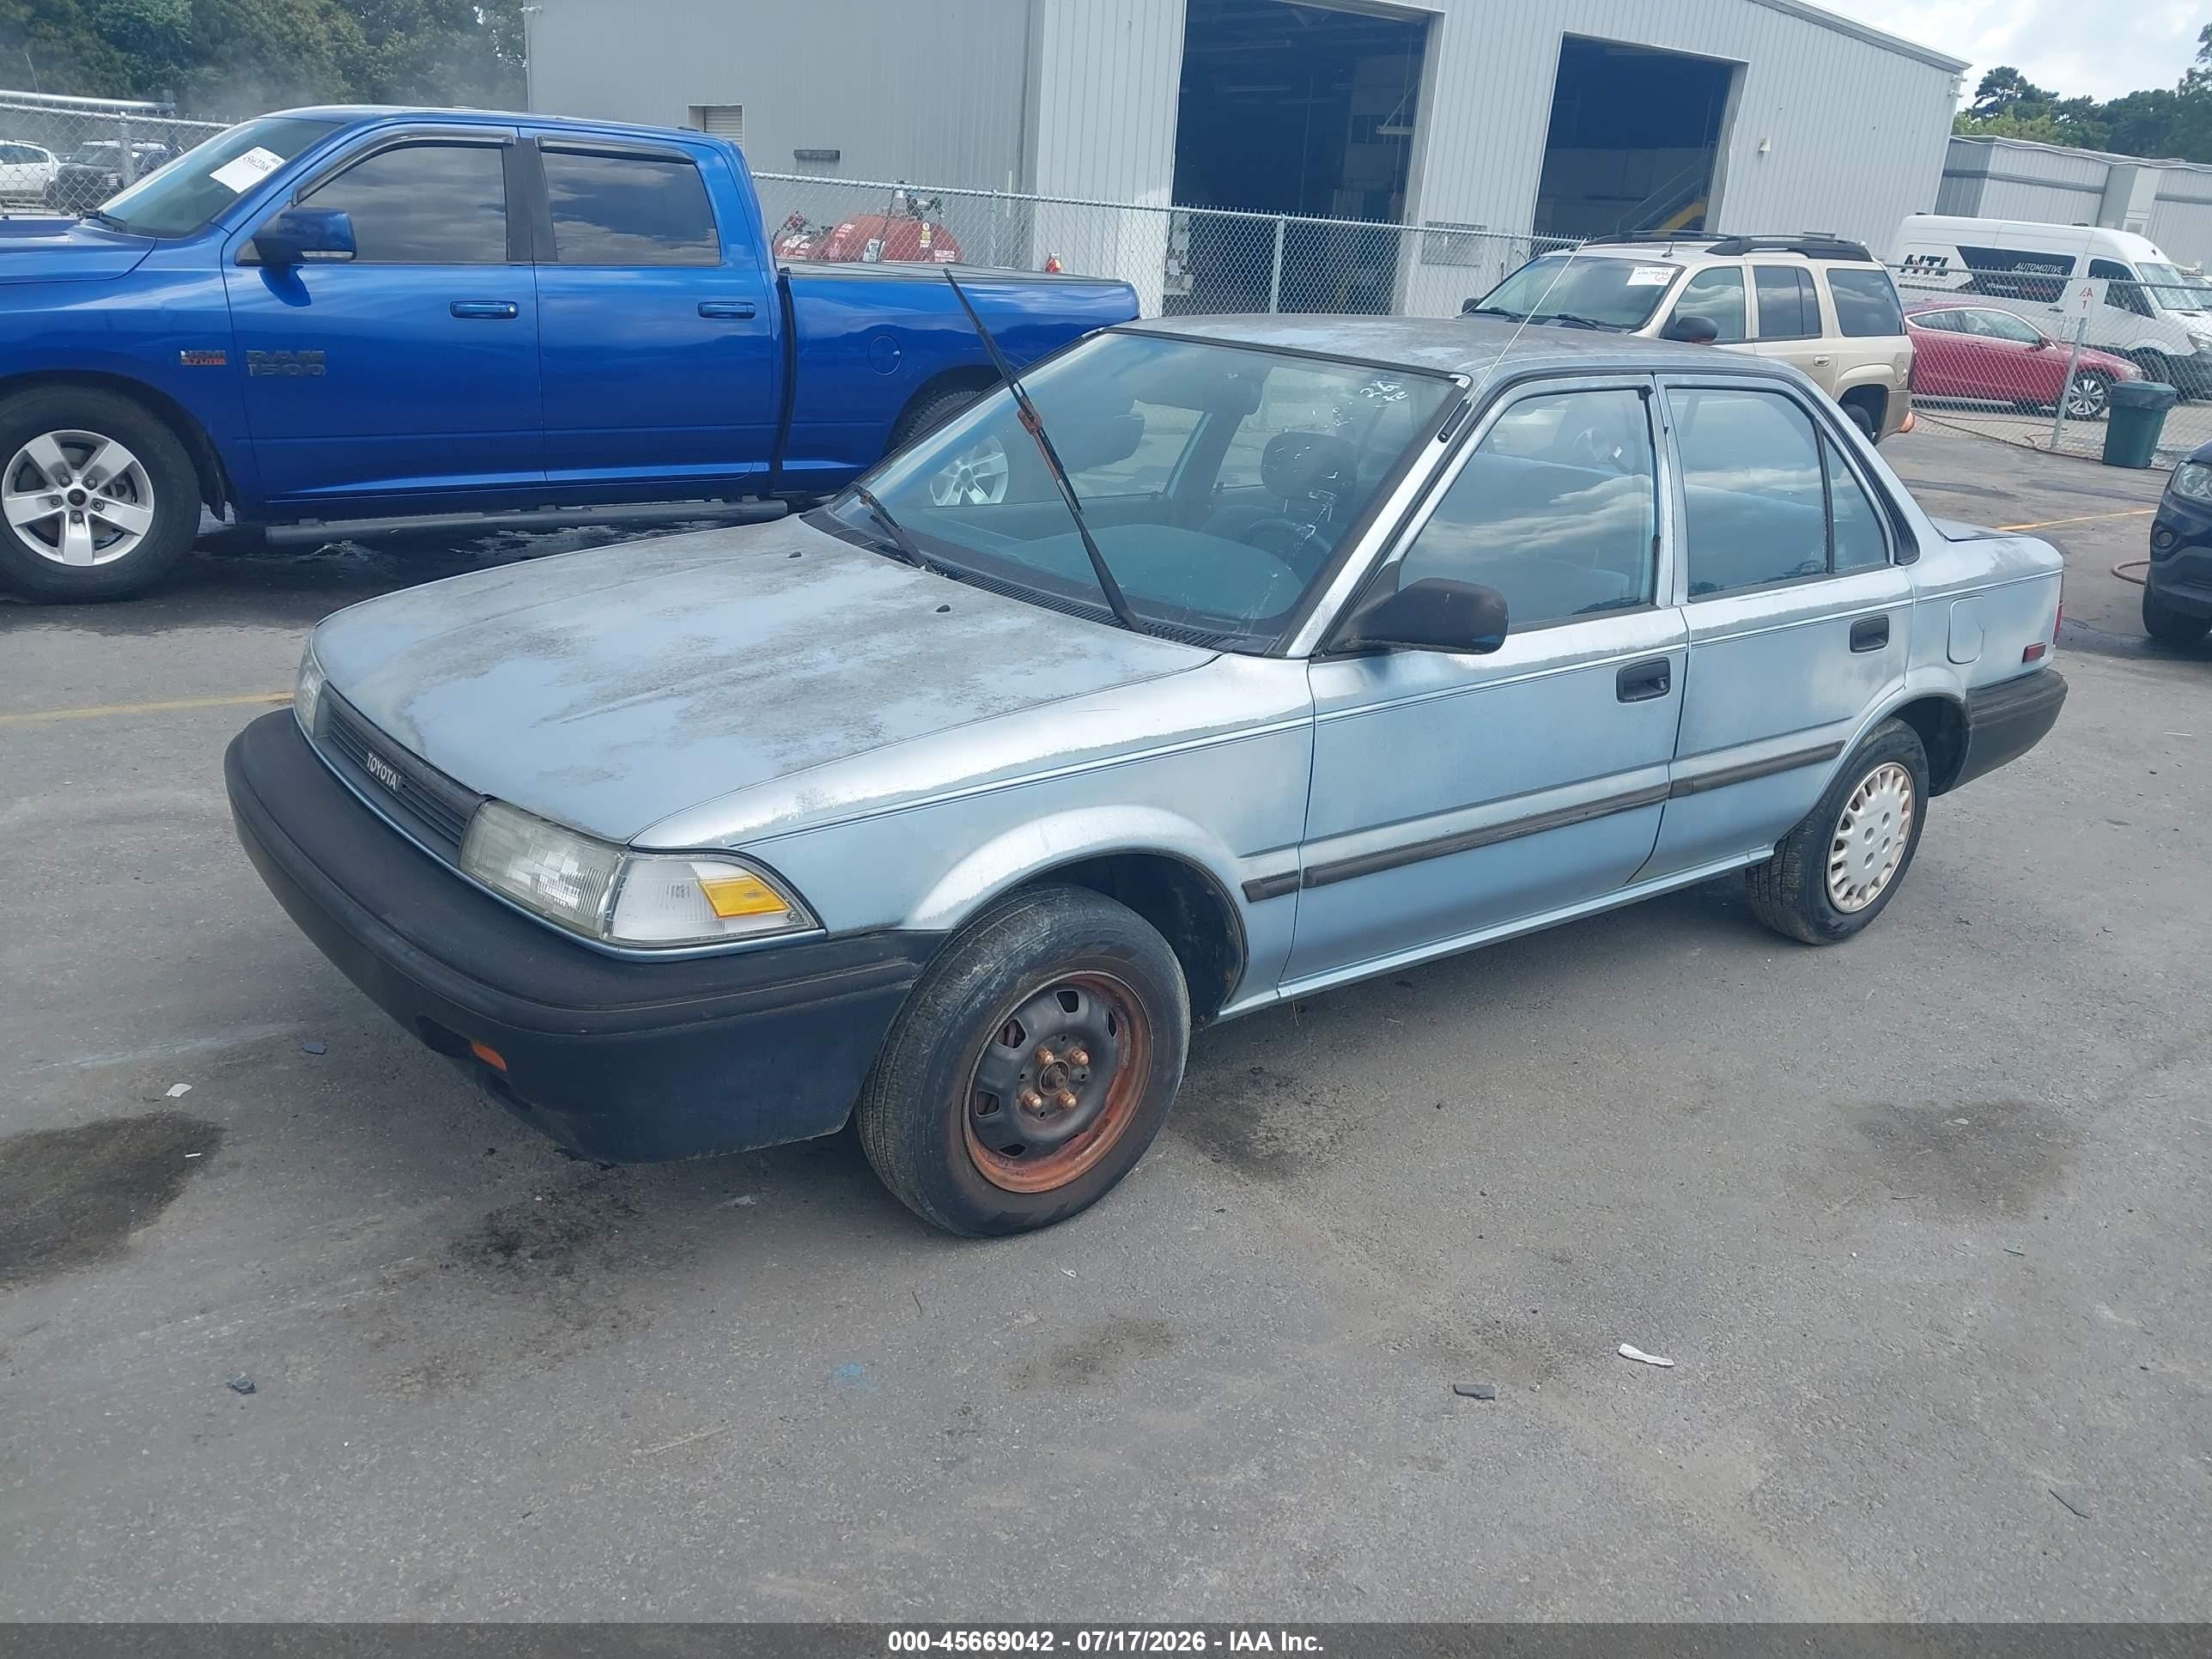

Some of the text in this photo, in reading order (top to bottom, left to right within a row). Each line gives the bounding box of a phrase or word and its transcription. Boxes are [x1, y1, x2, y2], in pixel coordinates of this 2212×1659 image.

[2014, 262, 2065, 274] AUTOMOTIVE
[246, 349, 325, 363] RAM
[367, 752, 398, 791] TOYOTA
